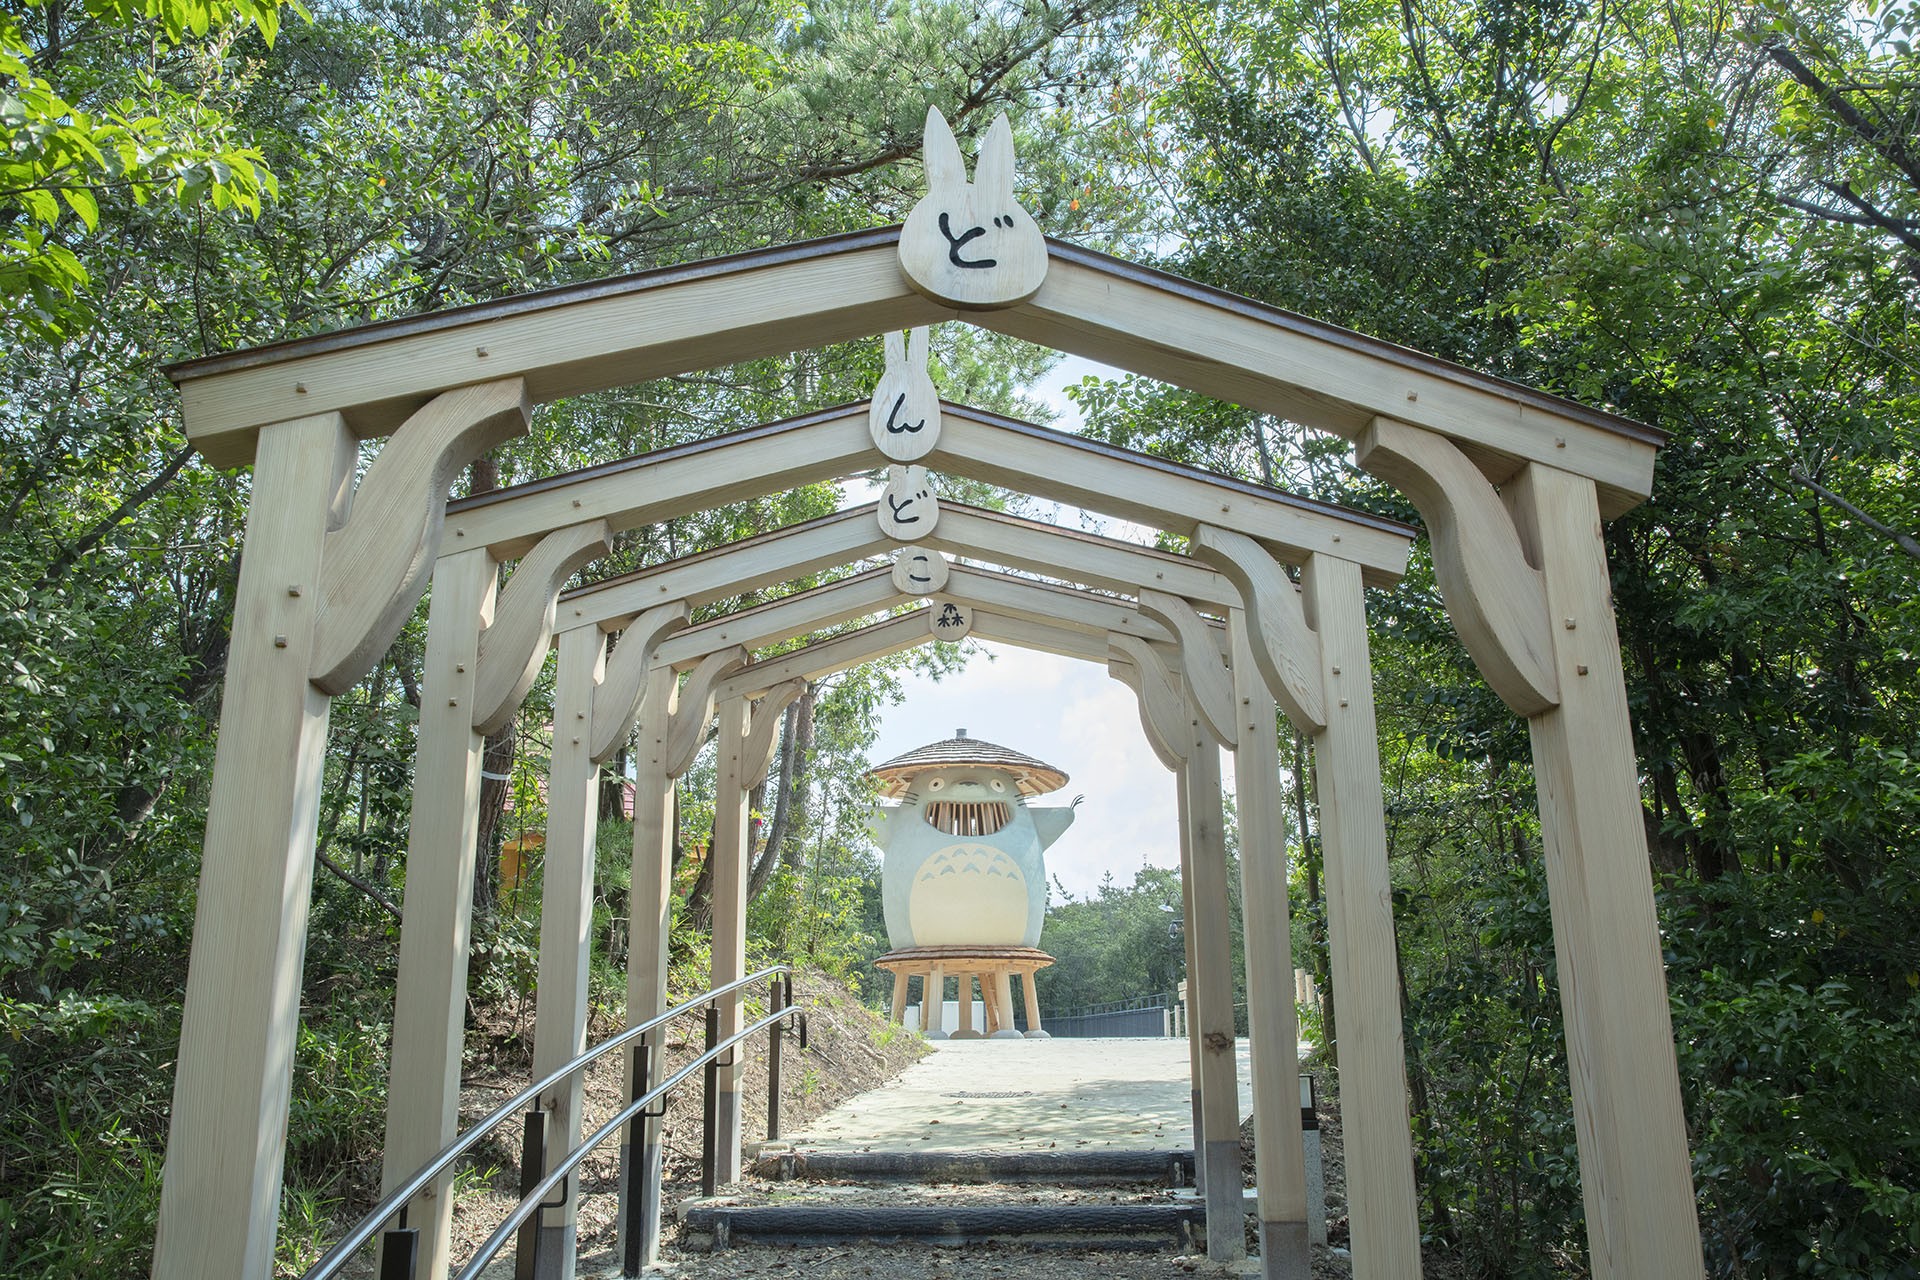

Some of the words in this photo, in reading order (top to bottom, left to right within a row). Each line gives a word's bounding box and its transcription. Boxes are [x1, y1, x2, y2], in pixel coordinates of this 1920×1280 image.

[938, 212, 1014, 269] ど
[887, 392, 925, 434] ん
[888, 489, 929, 524] ど
[909, 555, 931, 582] こ
[937, 602, 964, 628] 森
